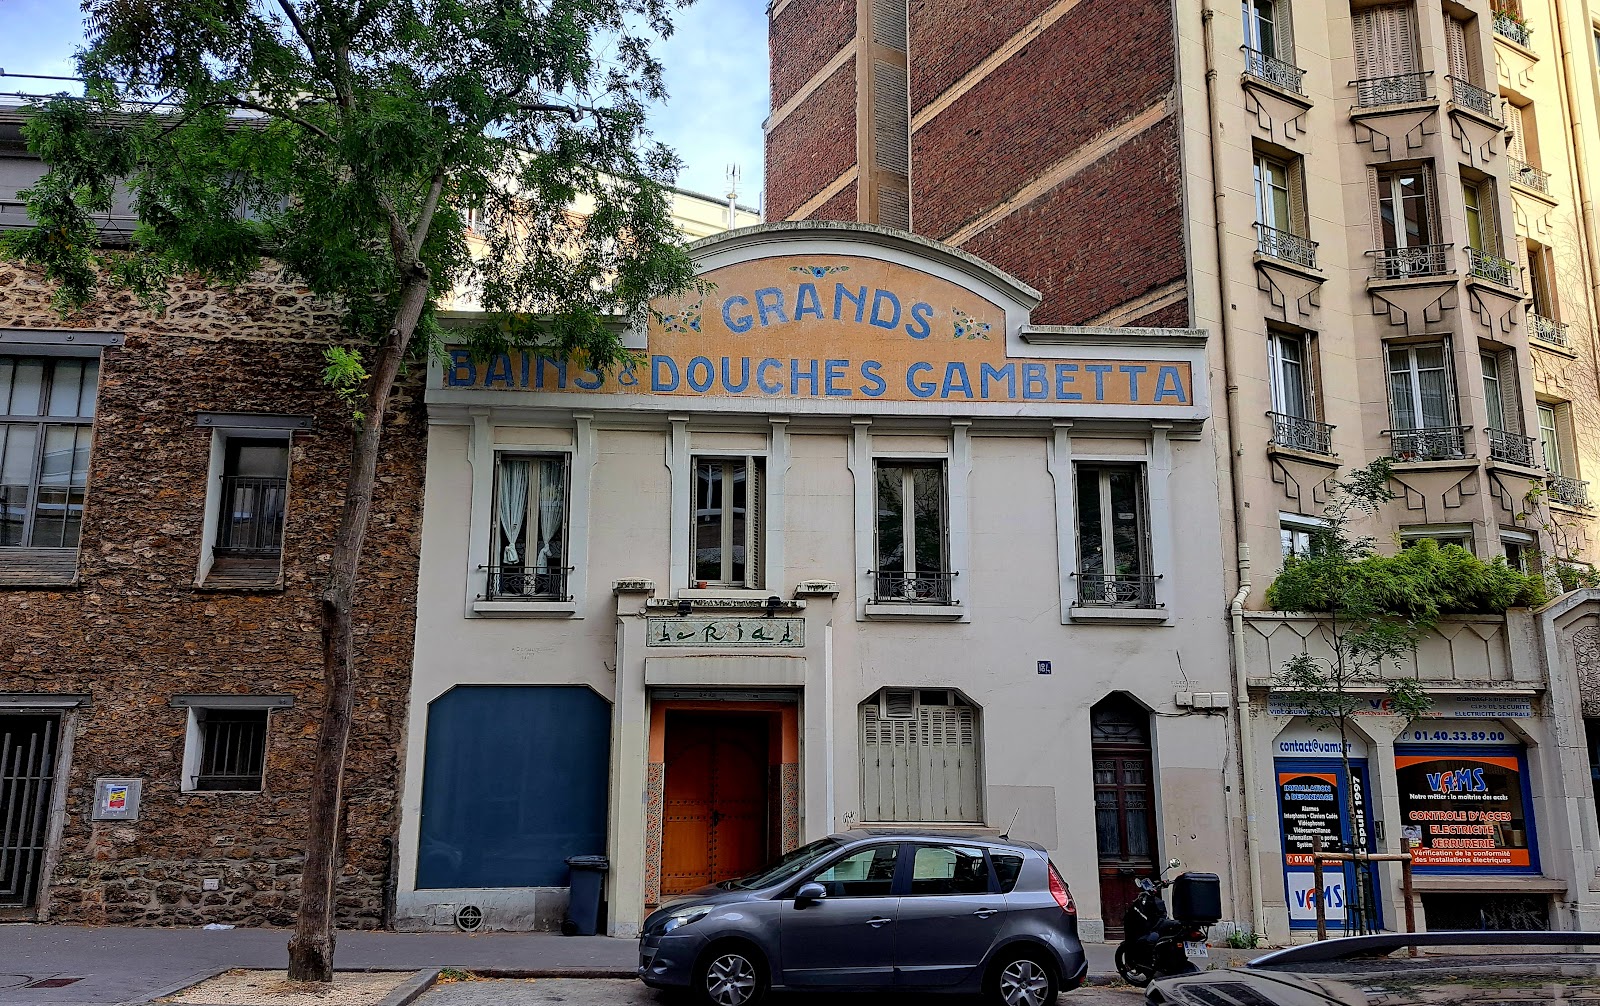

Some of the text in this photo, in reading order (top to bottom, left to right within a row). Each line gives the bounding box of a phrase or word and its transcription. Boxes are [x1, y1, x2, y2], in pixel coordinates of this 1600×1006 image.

[721, 282, 934, 340] GRANDS
[448, 350, 1187, 403] BAINS & DOUCHES GAMBETTA
[1414, 730, 1505, 741] 01.40.33.89.00
[1283, 784, 1332, 792] INSTALLATION
[1352, 776, 1363, 806] 1997
[1284, 793, 1334, 801] & DEPANNAGE
[1409, 810, 1512, 821] CONTROLE D'ACCES
[1429, 825, 1494, 835] ELECTRICITE
[1432, 838, 1495, 849] SERRURERIE
[1413, 849, 1453, 857] Vérification
